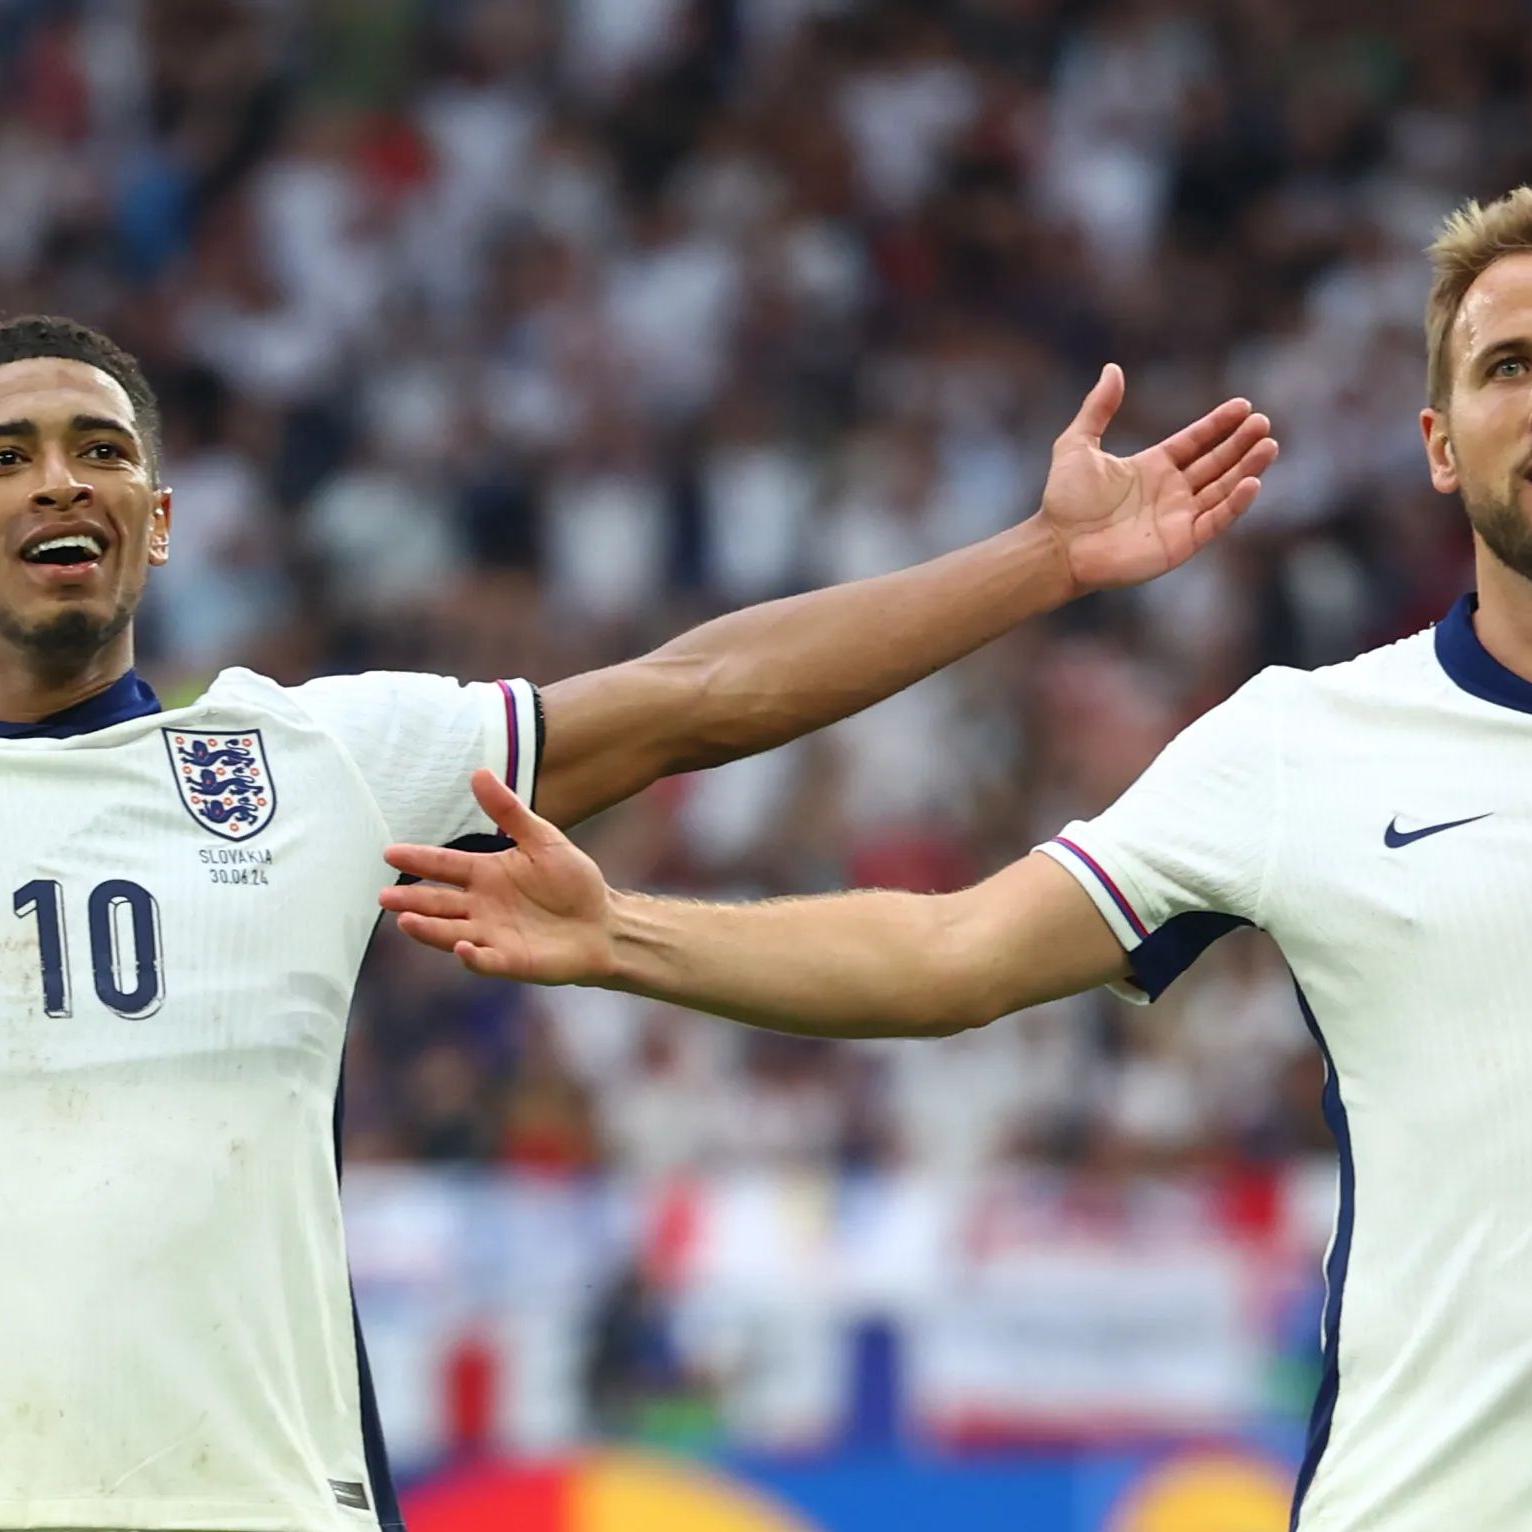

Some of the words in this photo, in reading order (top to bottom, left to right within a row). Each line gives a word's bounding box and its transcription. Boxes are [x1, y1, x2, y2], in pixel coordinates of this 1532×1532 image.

[198, 849, 273, 865] SLOVAKIA
[209, 868, 270, 885] 30.06.24
[13, 878, 166, 1020] 10
